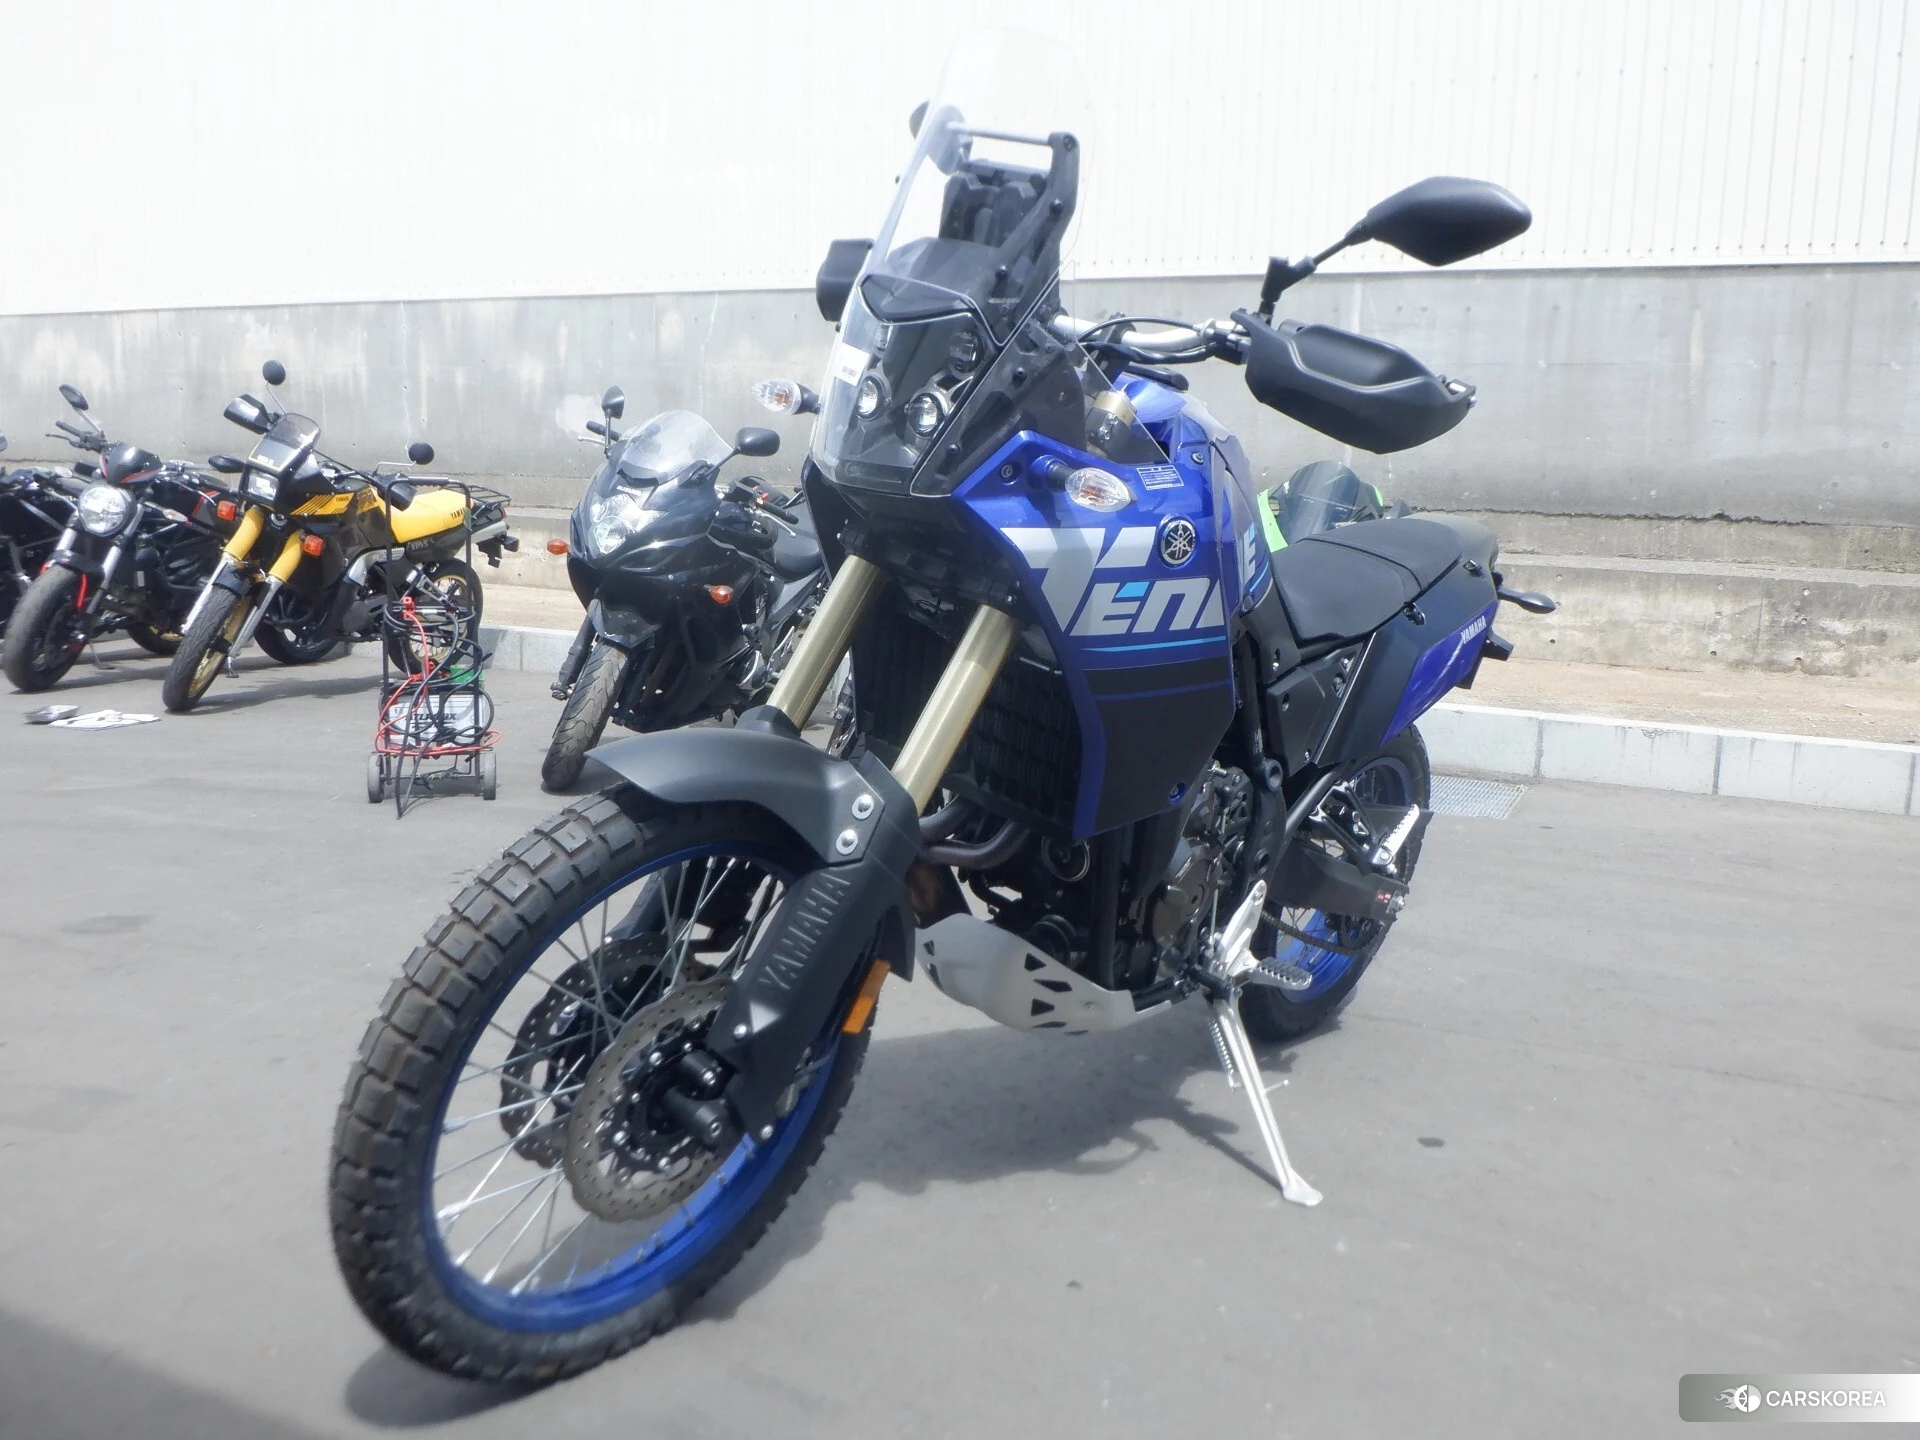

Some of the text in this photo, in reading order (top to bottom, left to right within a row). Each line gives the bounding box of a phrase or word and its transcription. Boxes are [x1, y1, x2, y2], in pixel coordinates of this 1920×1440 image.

[450, 507, 465, 520] YAMA
[1460, 615, 1487, 645] YAMAHA
[758, 872, 852, 990] YAMAHA
